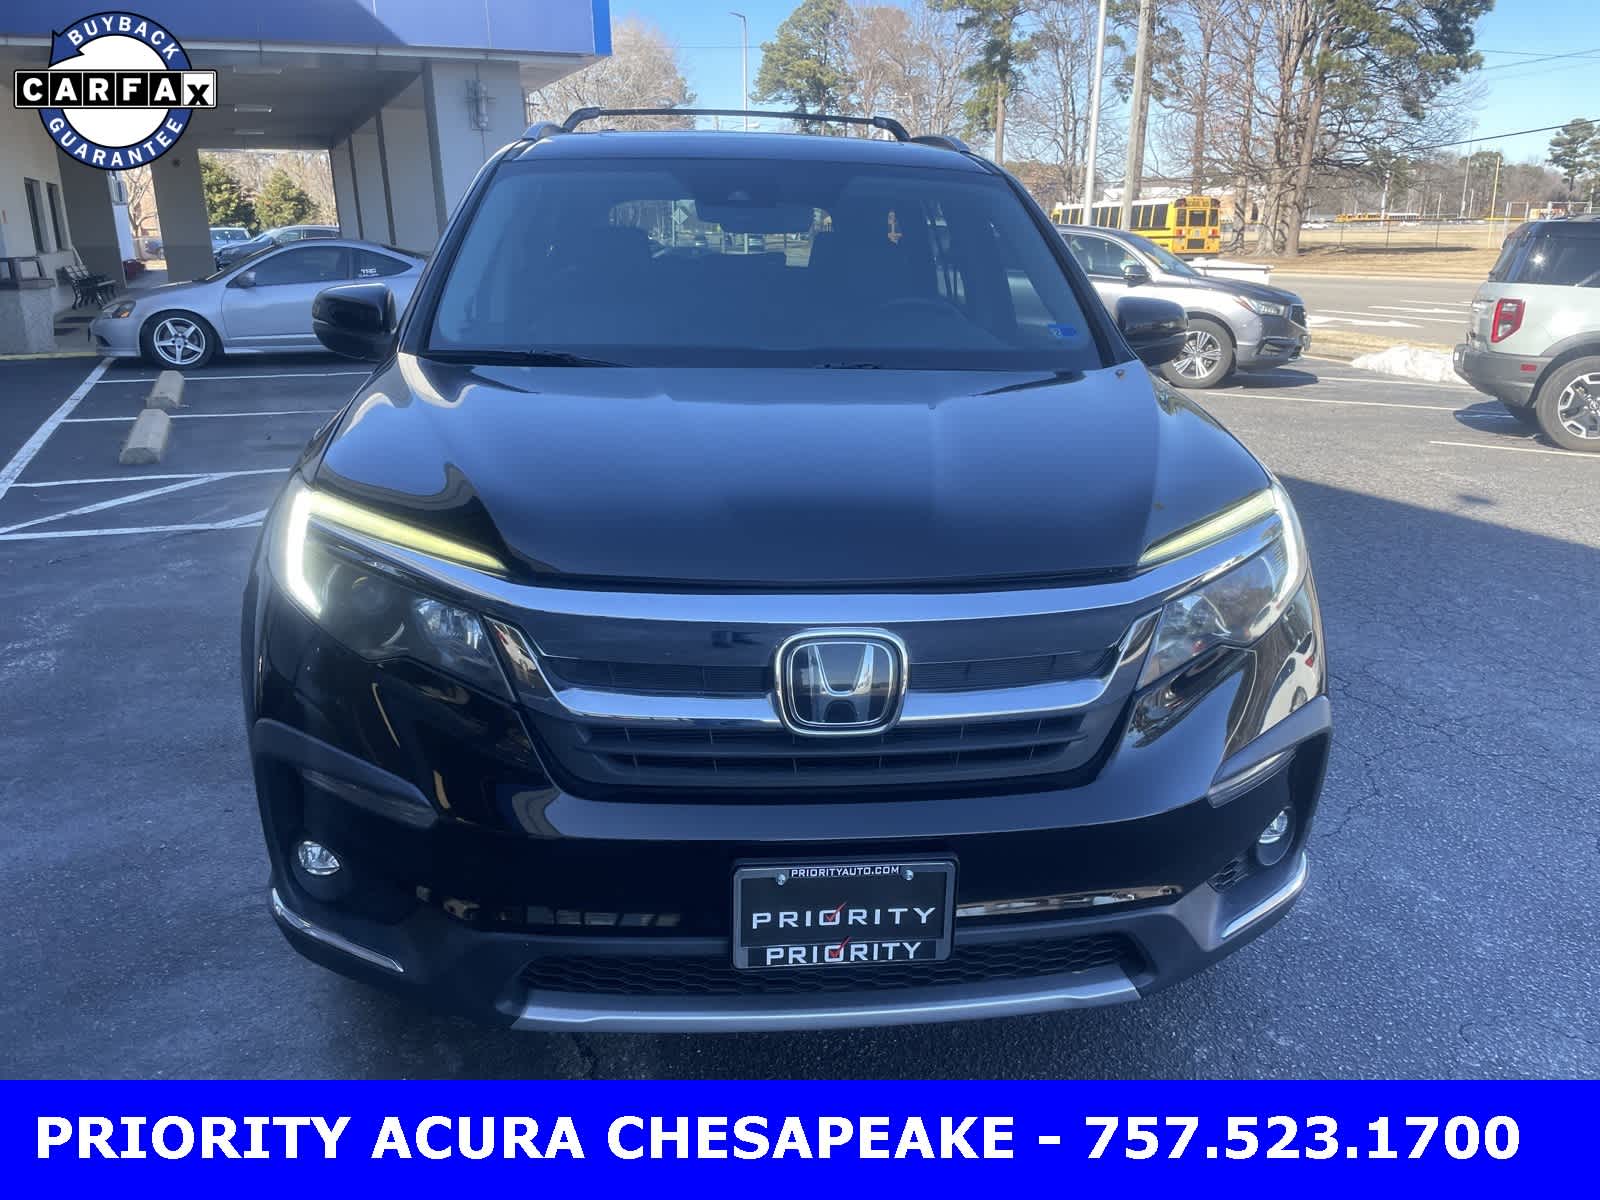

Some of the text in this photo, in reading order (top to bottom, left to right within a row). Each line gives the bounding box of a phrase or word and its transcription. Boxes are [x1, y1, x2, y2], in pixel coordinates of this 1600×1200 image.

[791, 865, 899, 878] PRIORITYAUTO.COM
[752, 906, 936, 930] PRIORITY
[766, 941, 922, 966] PRIORITY
